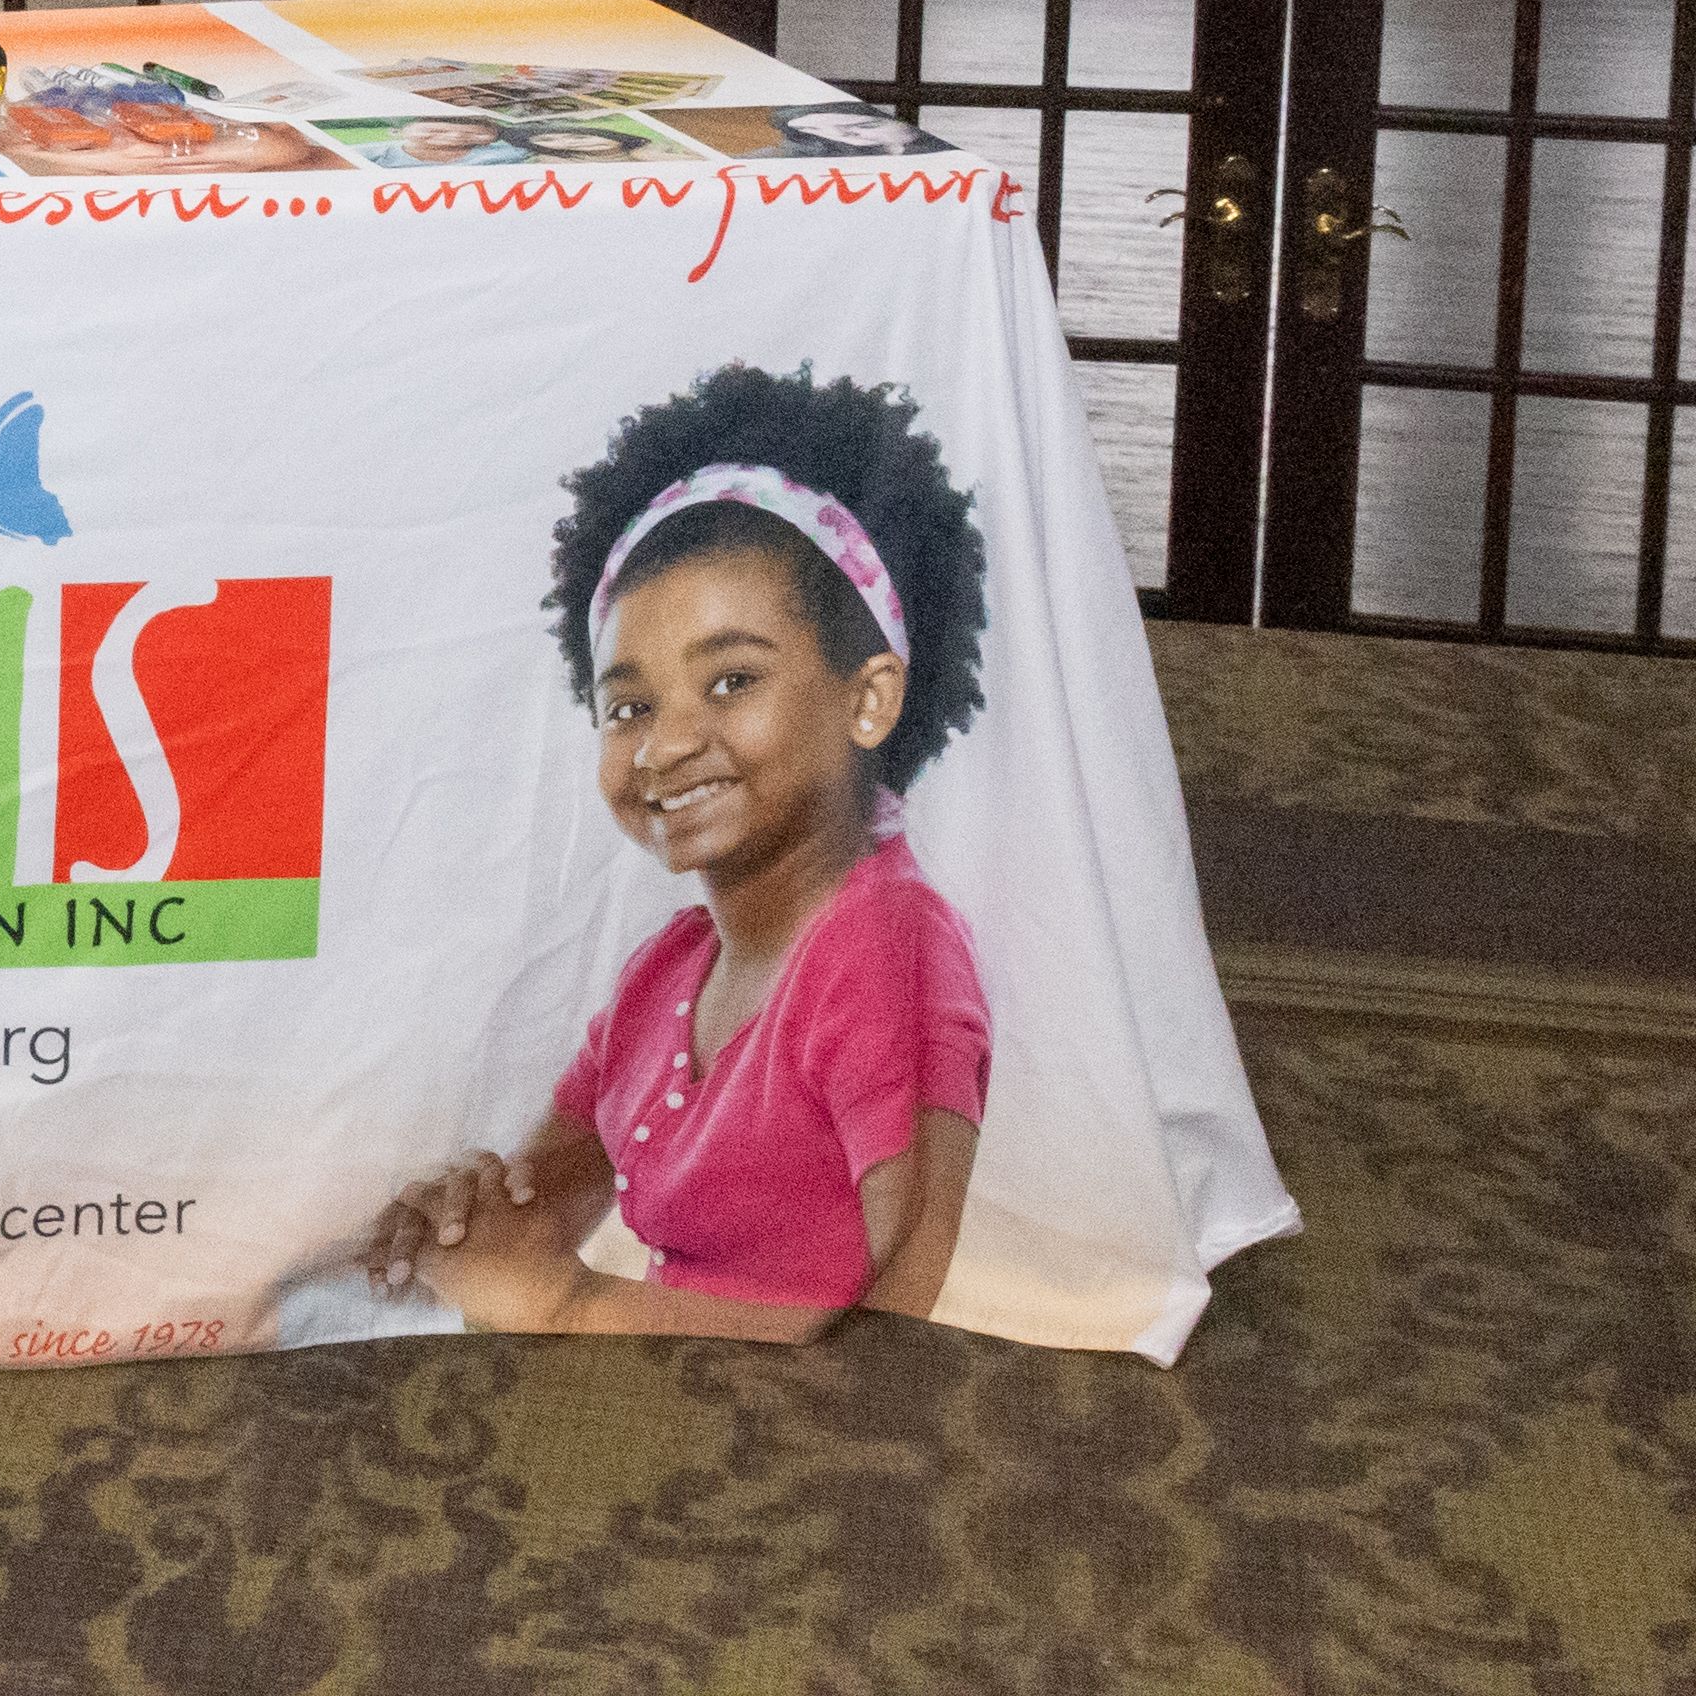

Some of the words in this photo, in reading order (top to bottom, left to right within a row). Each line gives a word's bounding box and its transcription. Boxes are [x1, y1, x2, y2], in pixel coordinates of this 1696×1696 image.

[372, 169, 594, 215] and
[620, 176, 695, 208] a
[64, 895, 188, 950] INC
[8, 1319, 117, 1359] since
[132, 1318, 226, 1354] 1978
